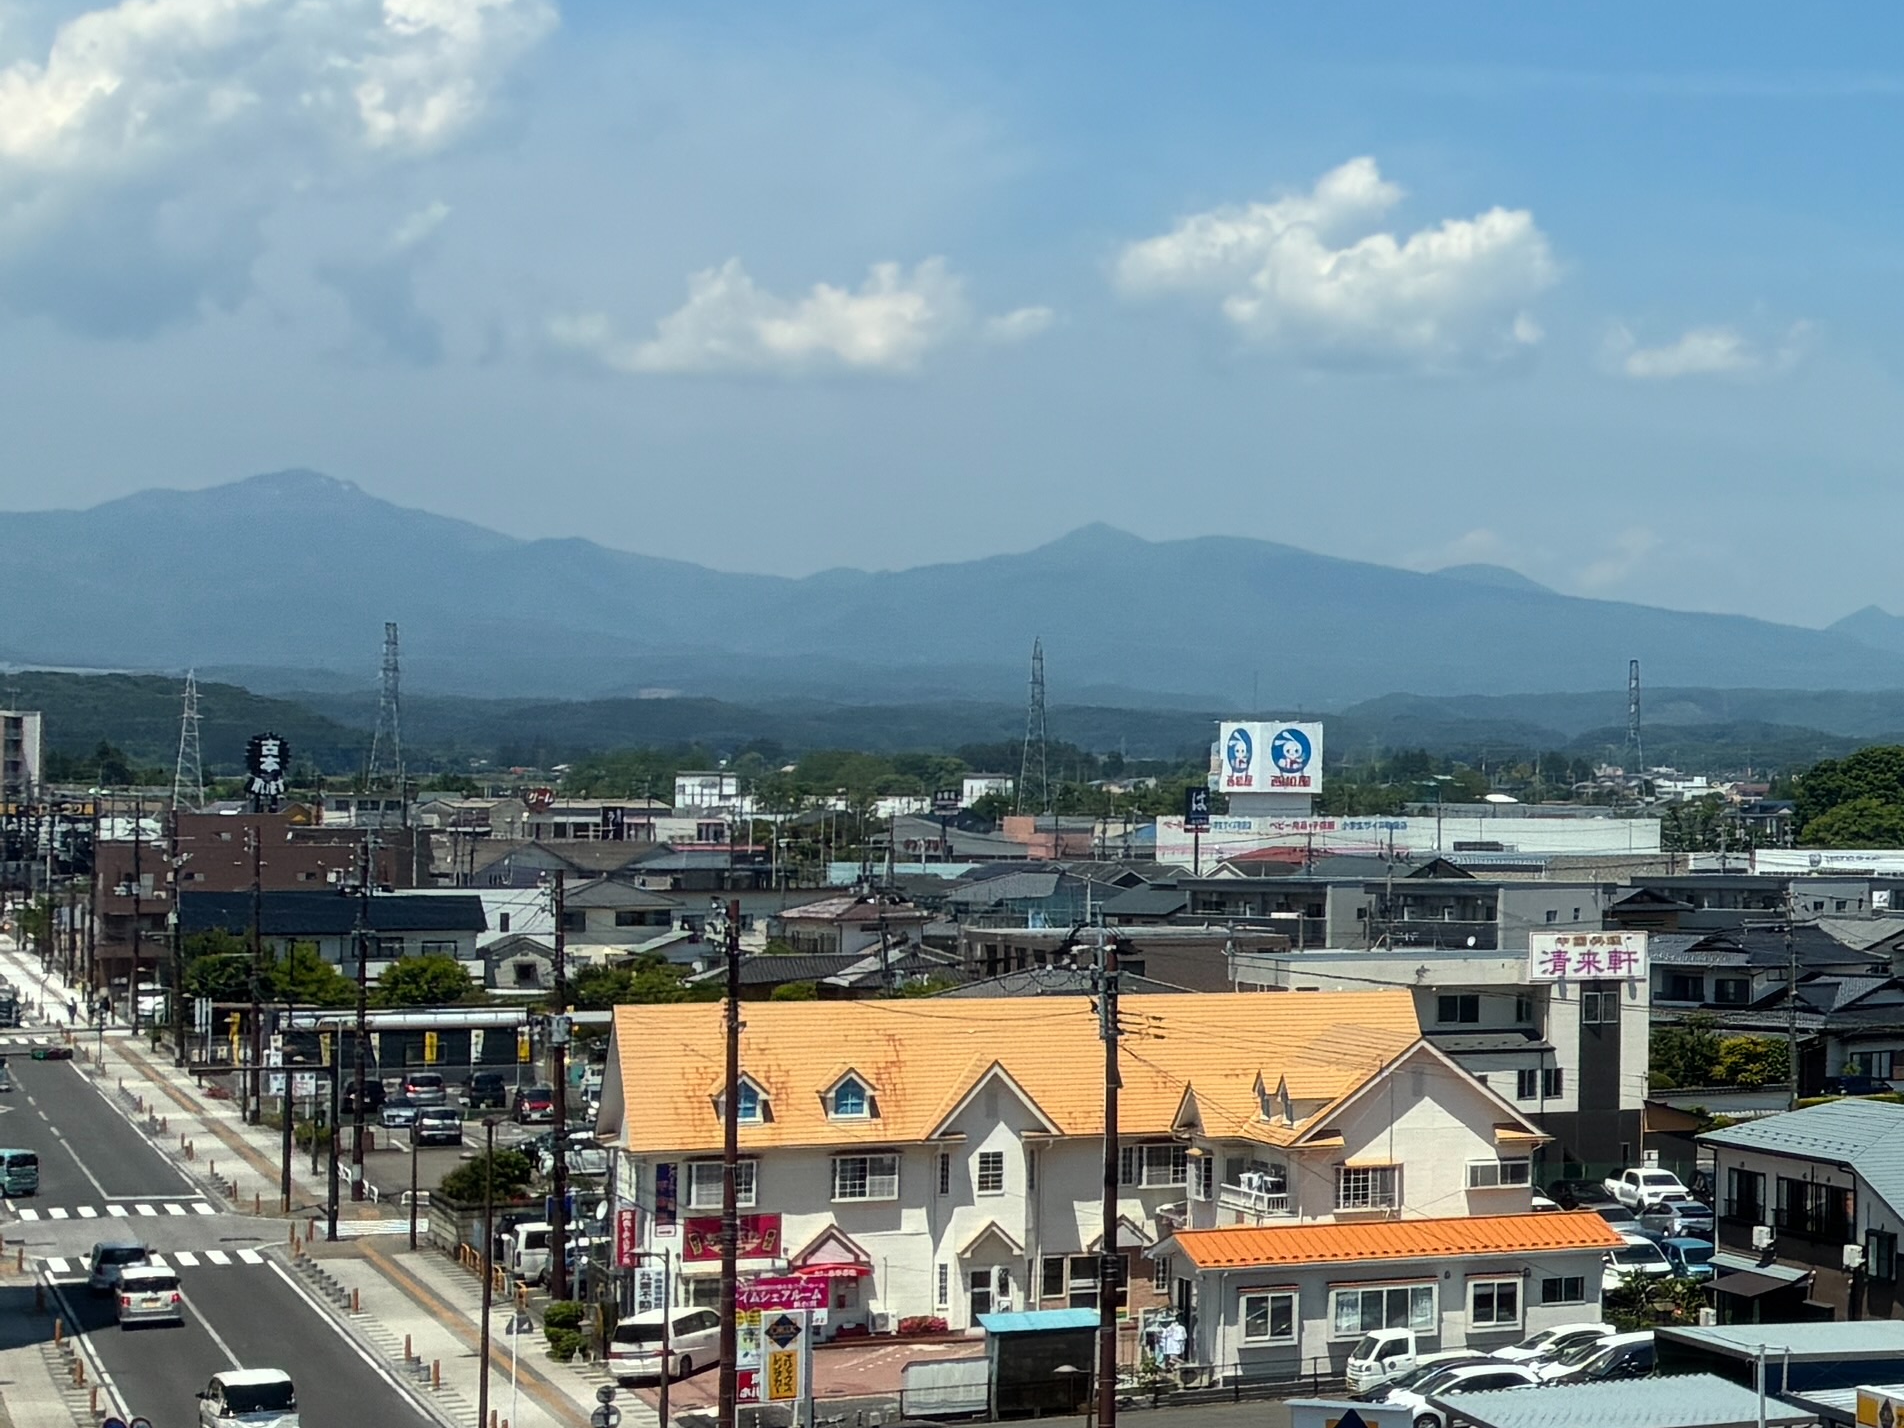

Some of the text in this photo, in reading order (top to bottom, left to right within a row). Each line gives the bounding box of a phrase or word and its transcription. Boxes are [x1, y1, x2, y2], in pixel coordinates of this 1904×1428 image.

[260, 738, 280, 772] 古本
[1539, 948, 1640, 975] 清来軒
[736, 1288, 821, 1303] イムシェアルーム
